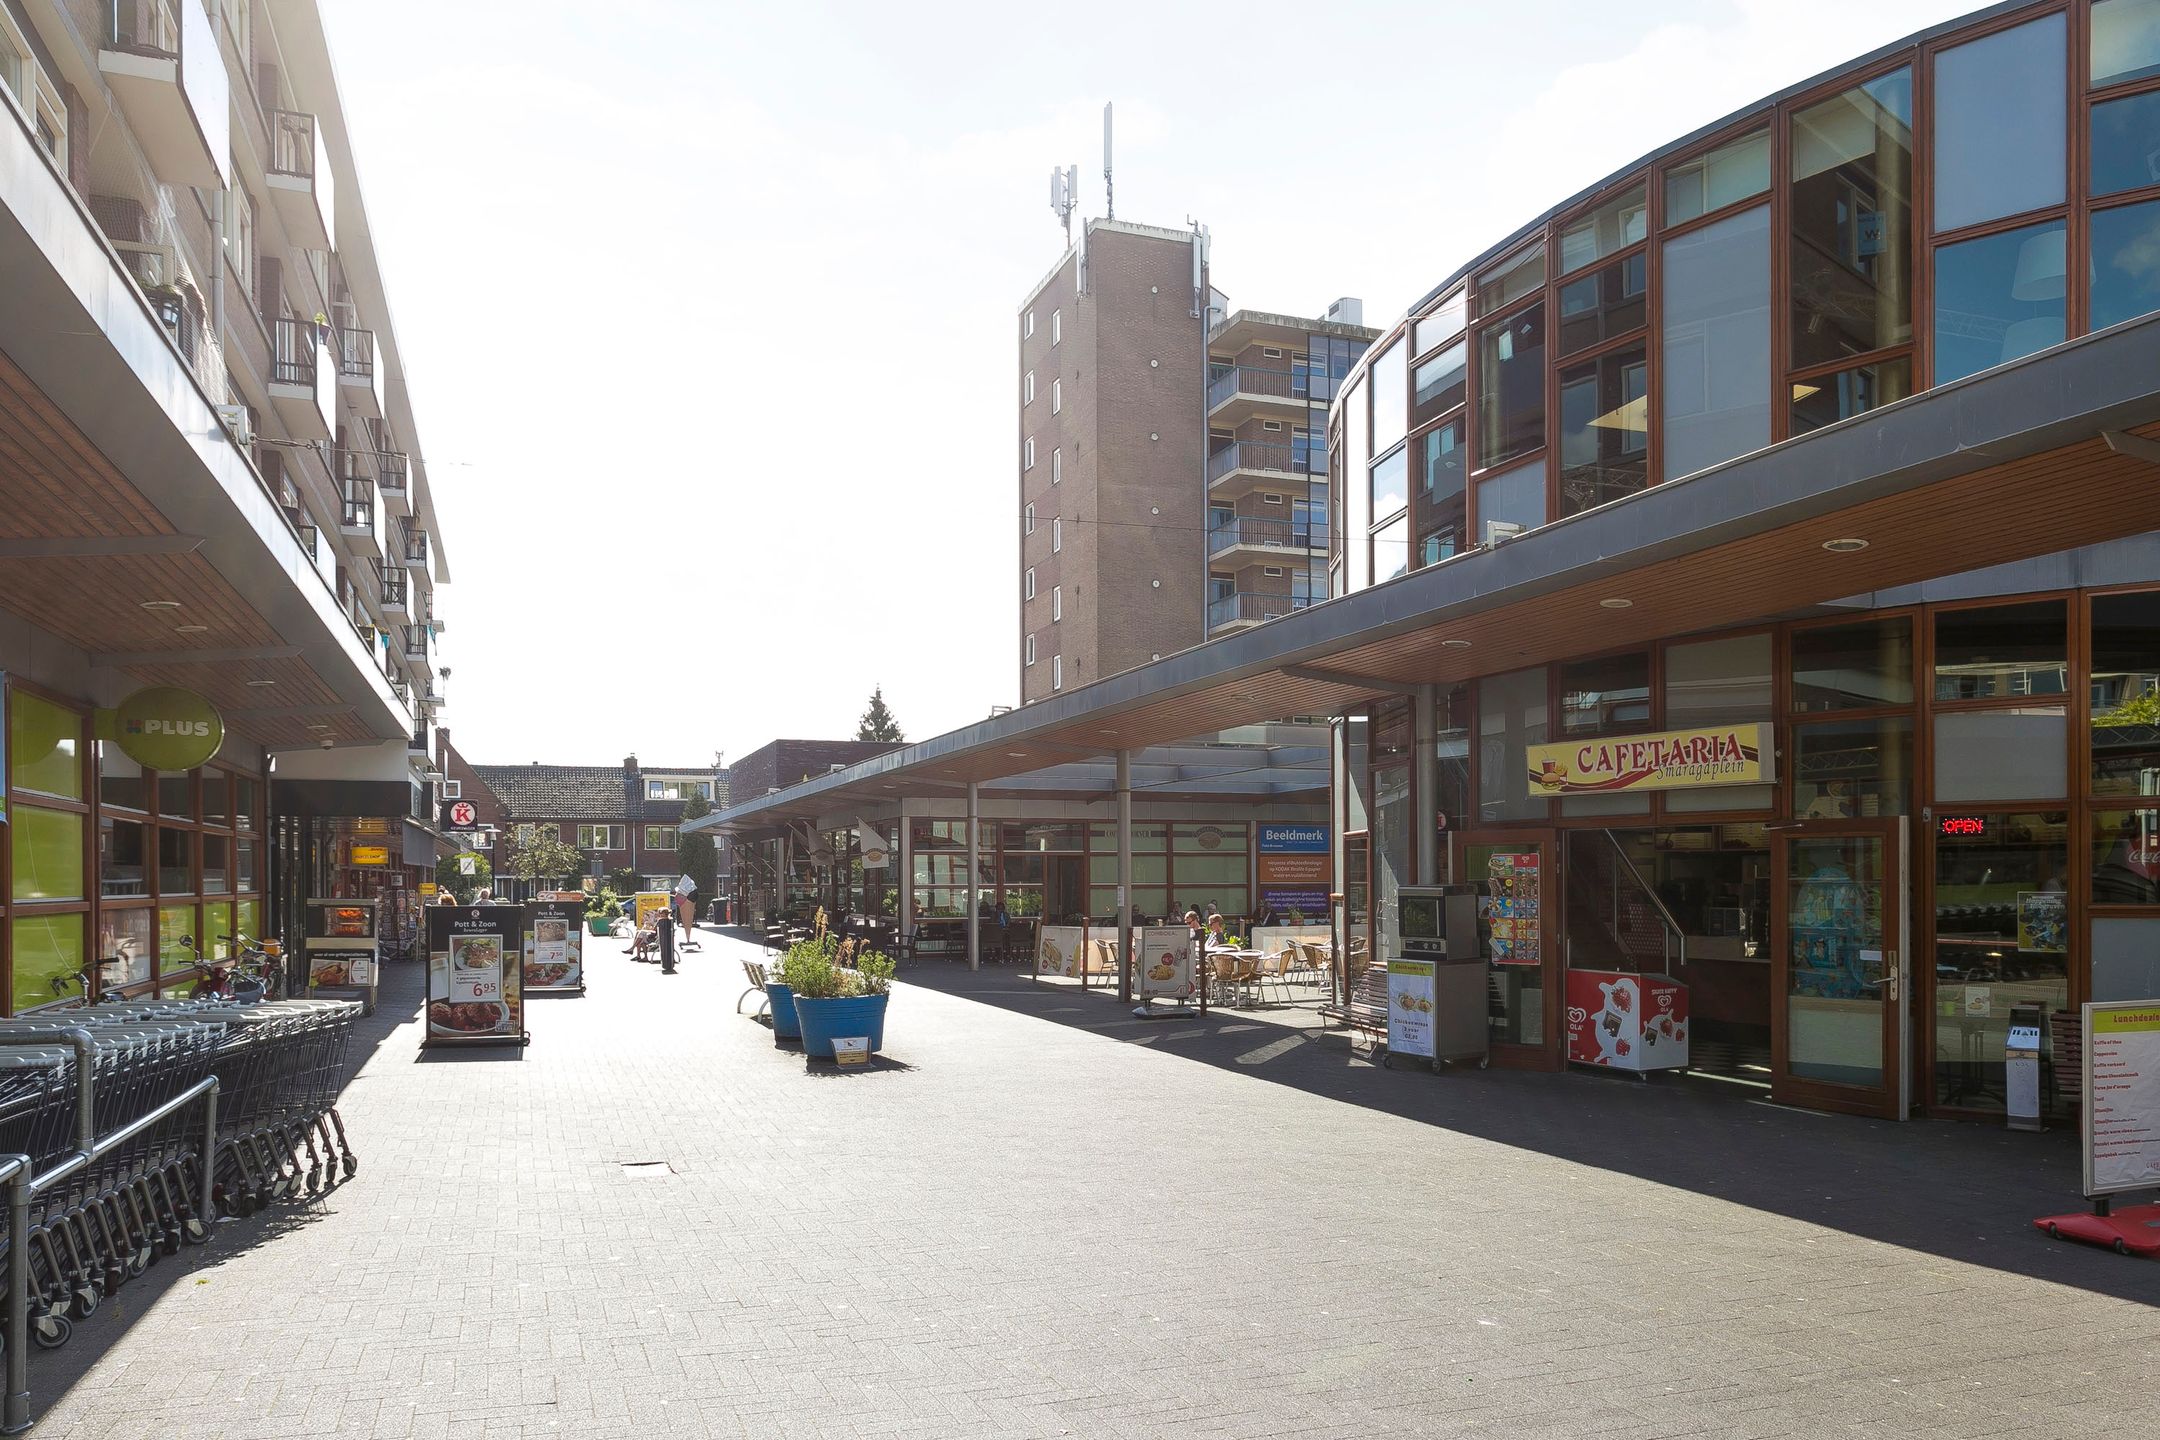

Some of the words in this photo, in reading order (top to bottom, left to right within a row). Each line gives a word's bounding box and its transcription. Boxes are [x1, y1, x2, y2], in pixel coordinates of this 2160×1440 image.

[144, 719, 209, 736] PLUS
[1577, 733, 1744, 777] CAFETARIA
[1656, 755, 1745, 781] Smaragdplein
[454, 808, 471, 823] K
[1944, 819, 1983, 832] OPEN
[1265, 829, 1324, 841] Beeldmerk
[454, 920, 471, 928] Pott
[471, 920, 477, 928] &
[478, 920, 497, 928] Zoon
[1569, 1023, 1583, 1031] OLA
